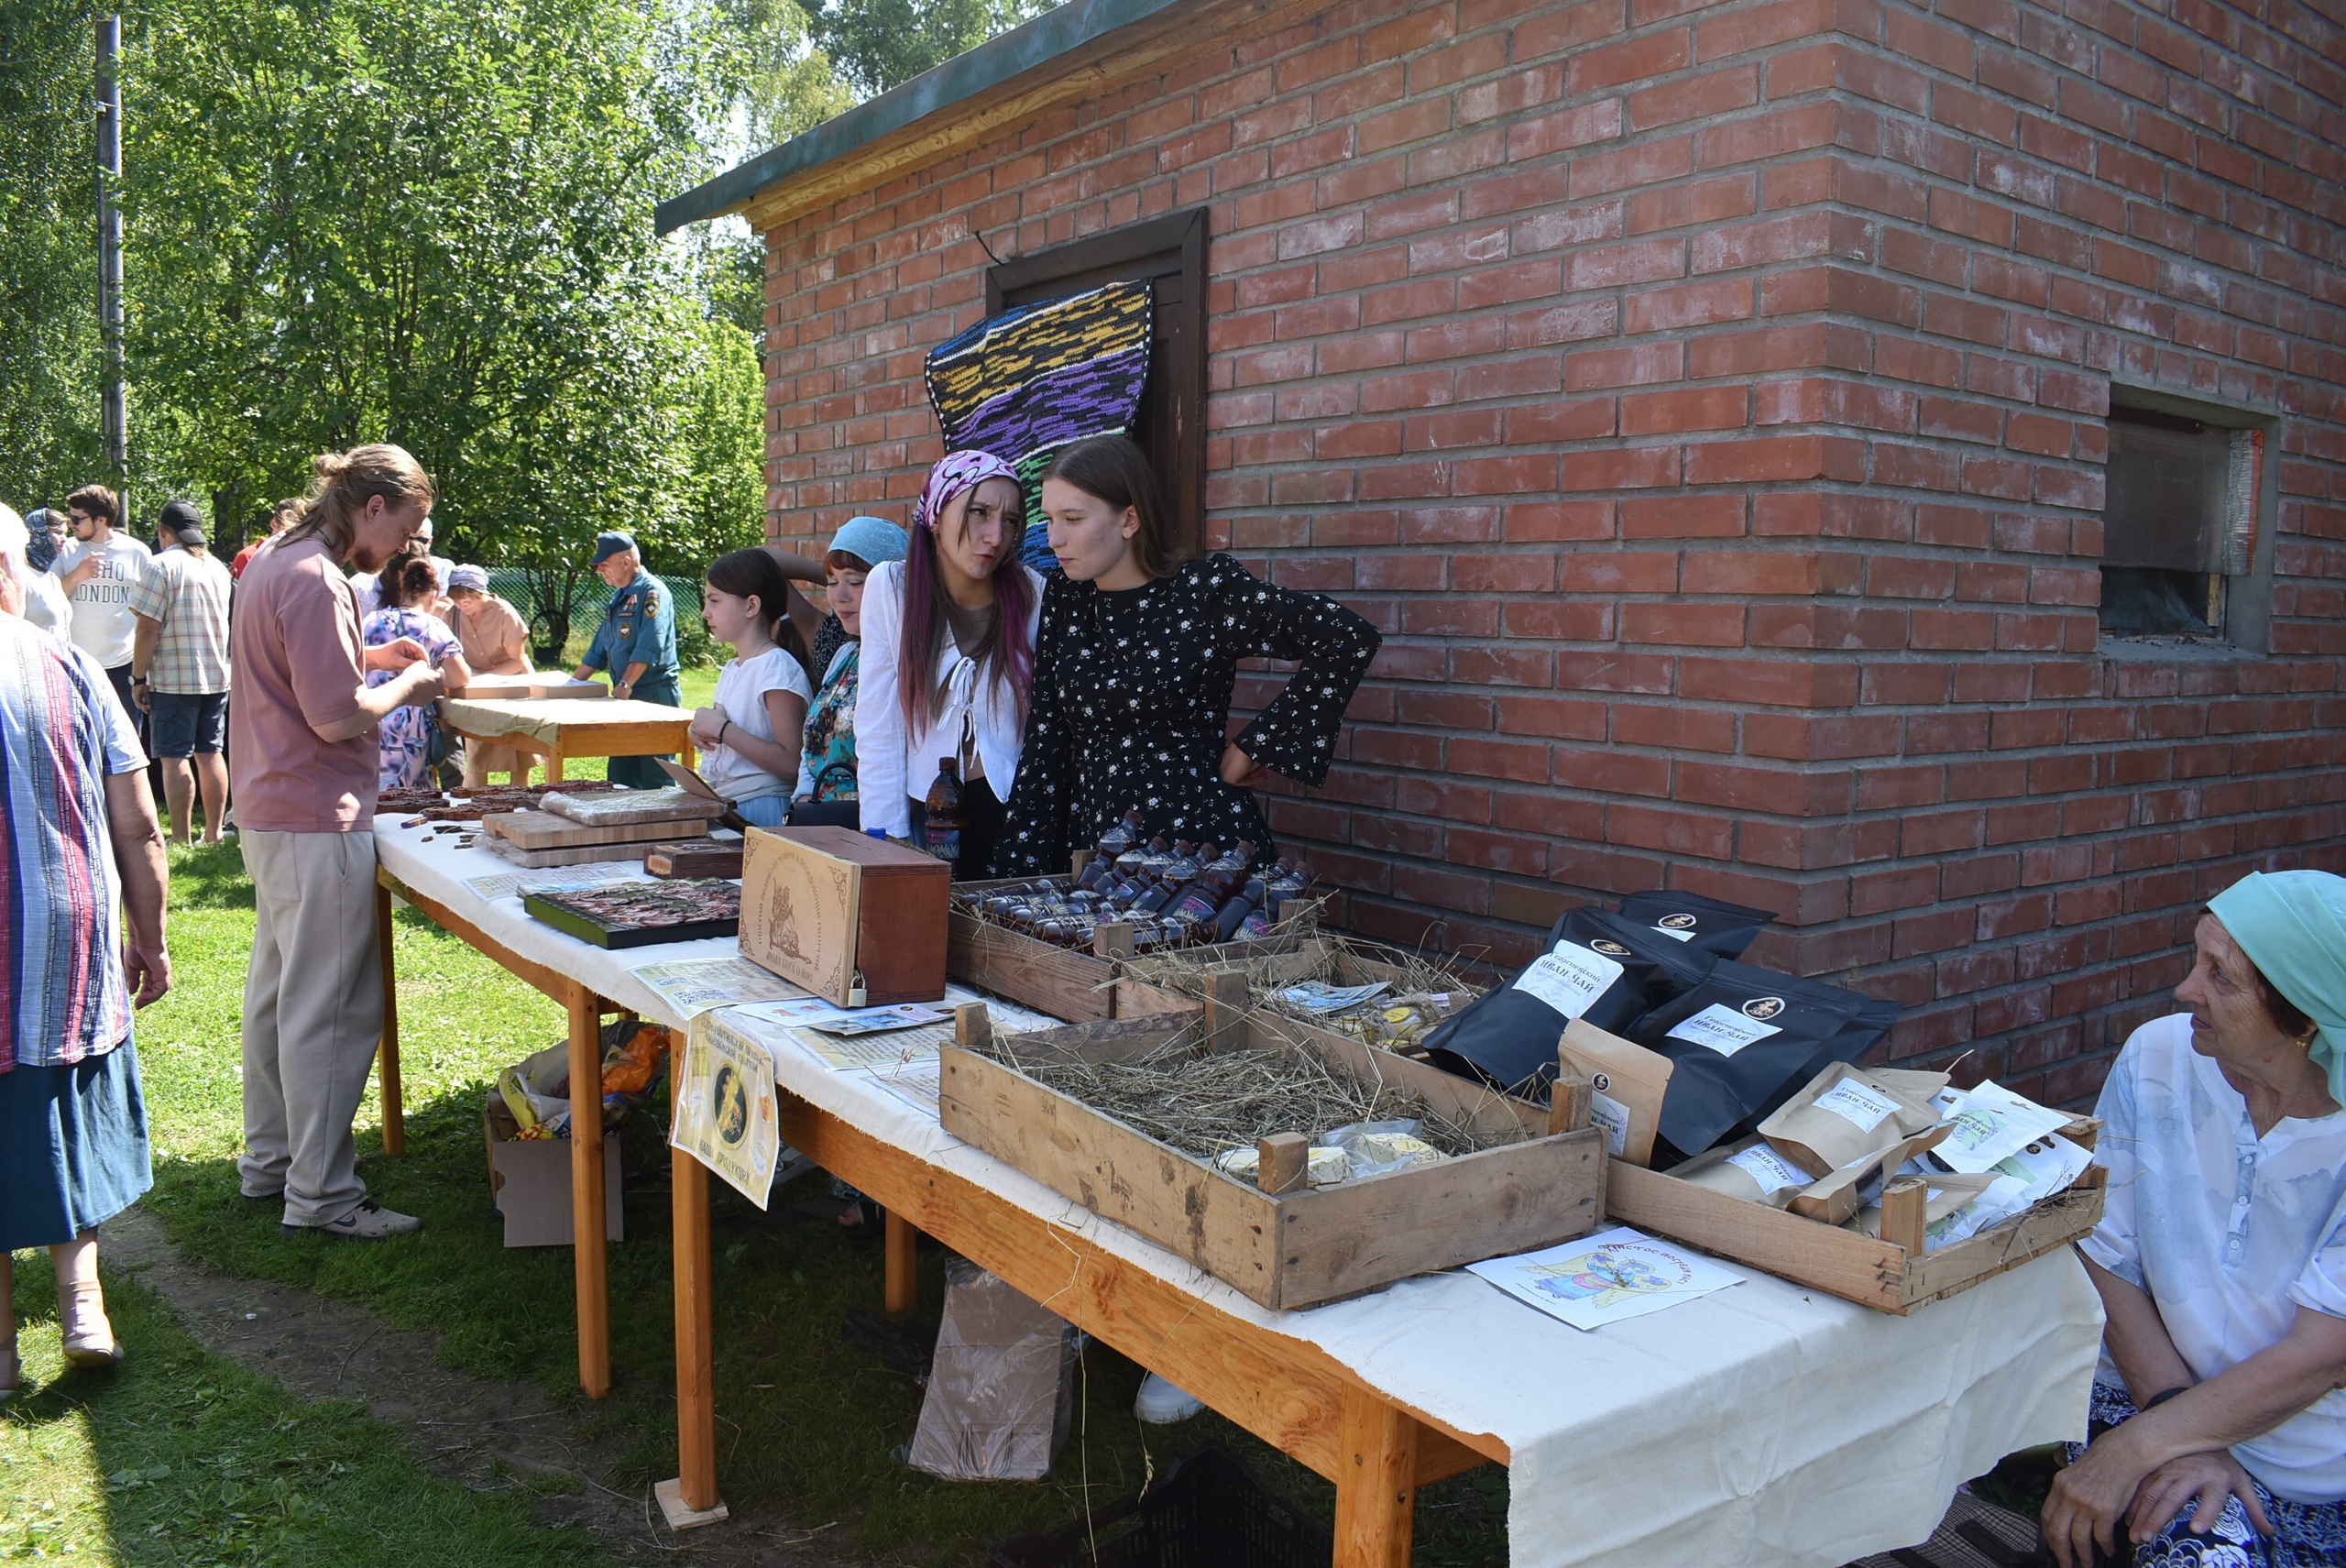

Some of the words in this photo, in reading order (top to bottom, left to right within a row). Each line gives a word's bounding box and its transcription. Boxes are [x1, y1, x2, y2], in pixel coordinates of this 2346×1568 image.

[75, 584, 130, 604] LONDON
[43, 846, 52, 872] AMSTERDAM
[1540, 959, 1595, 993] ИВАН-ЧАЙ
[1549, 952, 1601, 982] Георгиевский
[1694, 1020, 1749, 1041] ИВАН-ЧАЙ
[1705, 1015, 1756, 1036] Георгиевский
[1834, 1091, 1881, 1114] ИВАН-ЧАЙ
[716, 1151, 750, 1185] ПРОДУКЦИЯ
